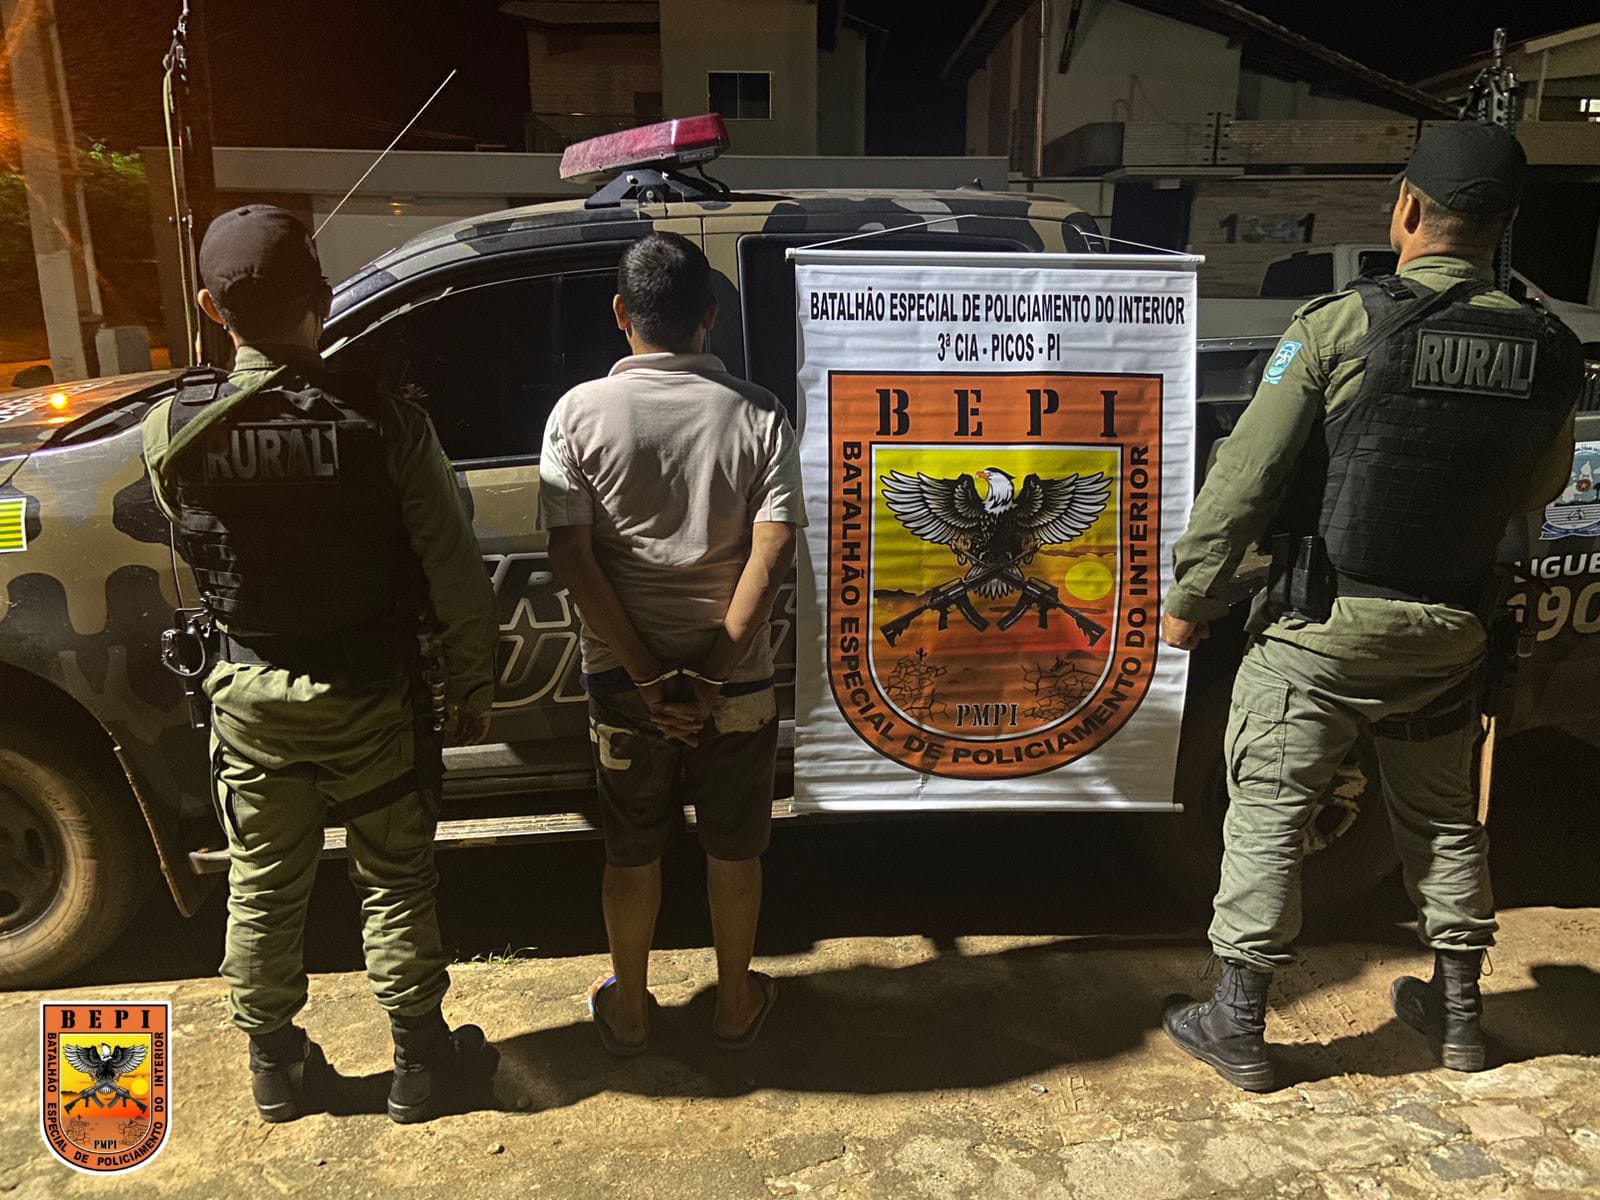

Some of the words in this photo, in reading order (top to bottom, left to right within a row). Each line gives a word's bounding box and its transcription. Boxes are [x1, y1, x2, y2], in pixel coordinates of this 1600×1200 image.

[810, 286, 885, 321] BATALHÃO
[890, 293, 957, 322] ESPECIAL
[962, 294, 980, 322] DE
[985, 294, 1090, 323] POLICIAMENTO
[1095, 295, 1114, 323] DO
[1119, 296, 1185, 324] INTERIOR
[937, 333, 950, 361] 3ª
[955, 333, 978, 361] CIA
[992, 333, 1034, 361] PICOS
[1047, 333, 1060, 361] PI
[1418, 335, 1528, 392] RURAL
[207, 428, 334, 479] RURAL
[841, 442, 864, 606] BATALHÃO
[1129, 445, 1149, 596] INTERIOR
[1125, 607, 1147, 648] DO
[840, 617, 895, 742] ESPECIAL
[951, 656, 1143, 765] POLICIAMENTO
[955, 703, 1018, 728] PMPI
[902, 735, 944, 760] DE
